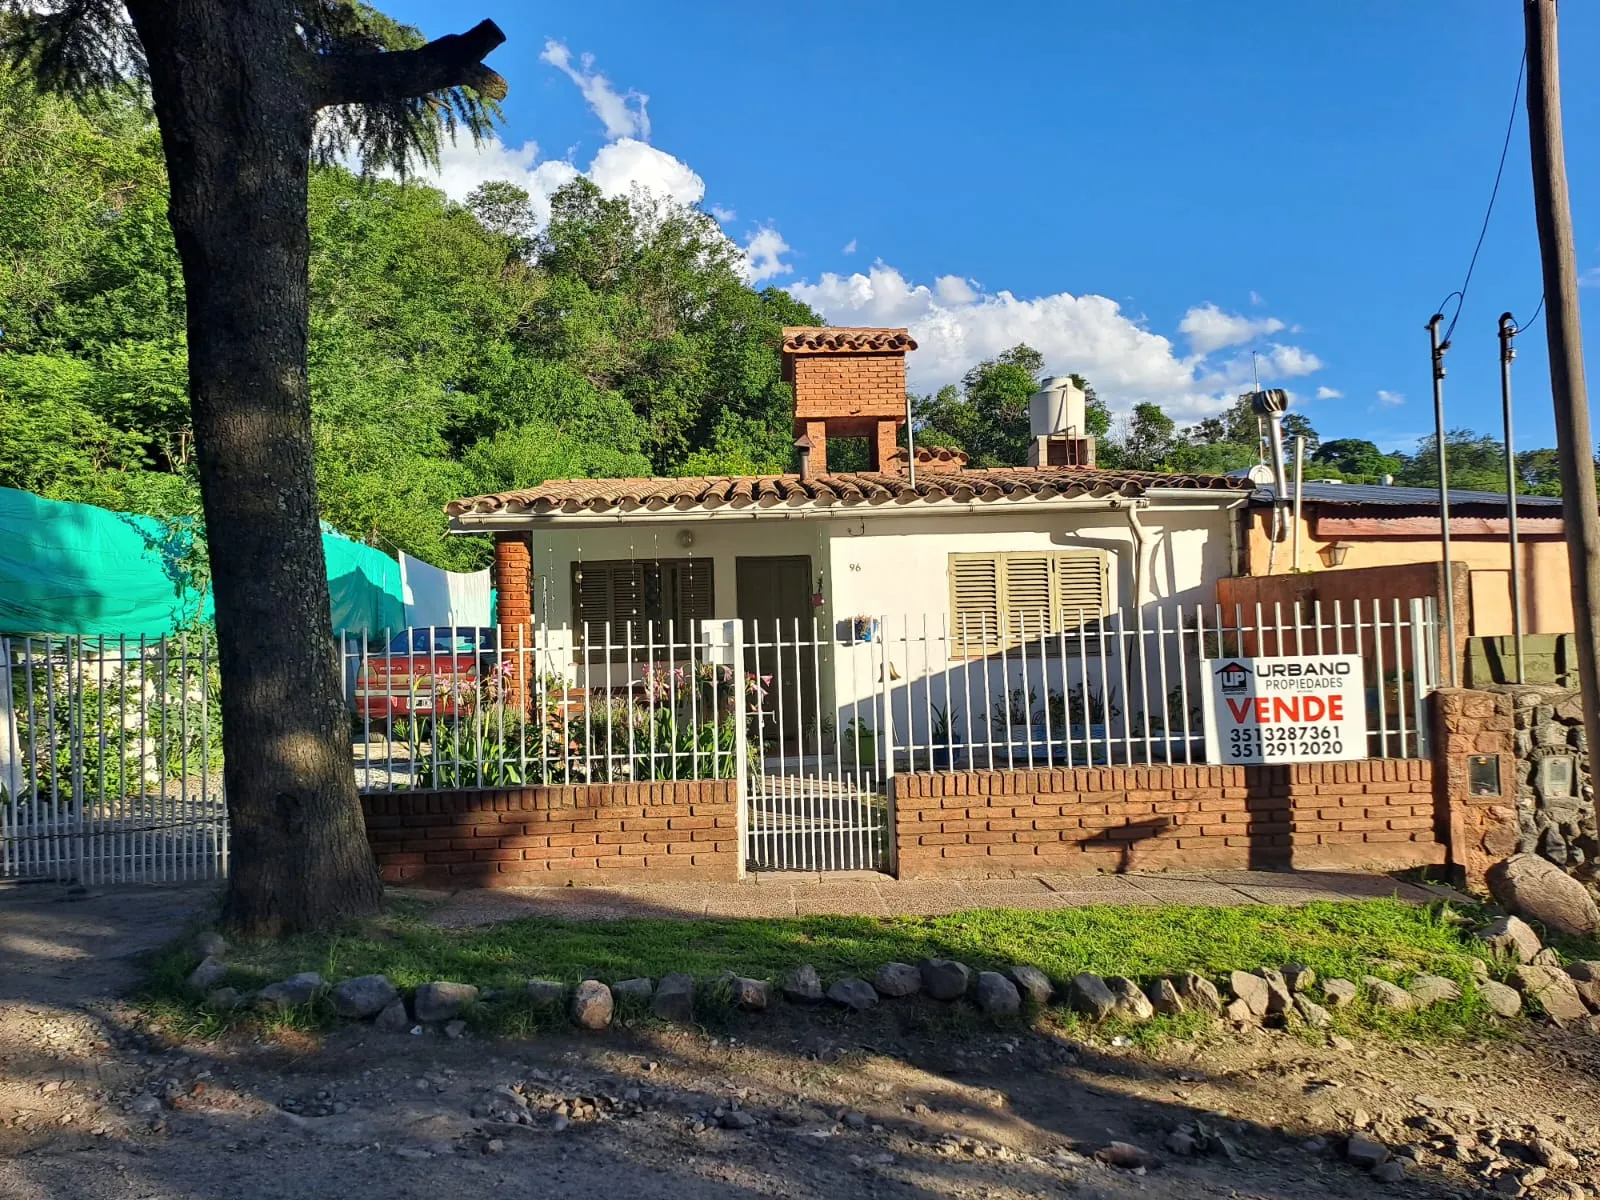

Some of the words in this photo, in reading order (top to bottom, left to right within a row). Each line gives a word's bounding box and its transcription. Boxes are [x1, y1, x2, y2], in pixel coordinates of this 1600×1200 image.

[849, 563, 862, 572] 96
[1256, 662, 1350, 677] URBANO
[1222, 672, 1245, 686] UP
[1266, 678, 1343, 690] PROPIEDADES
[1226, 695, 1344, 724] VENDE
[1230, 726, 1340, 742] 3513287361
[1231, 741, 1343, 758] 3512912020
